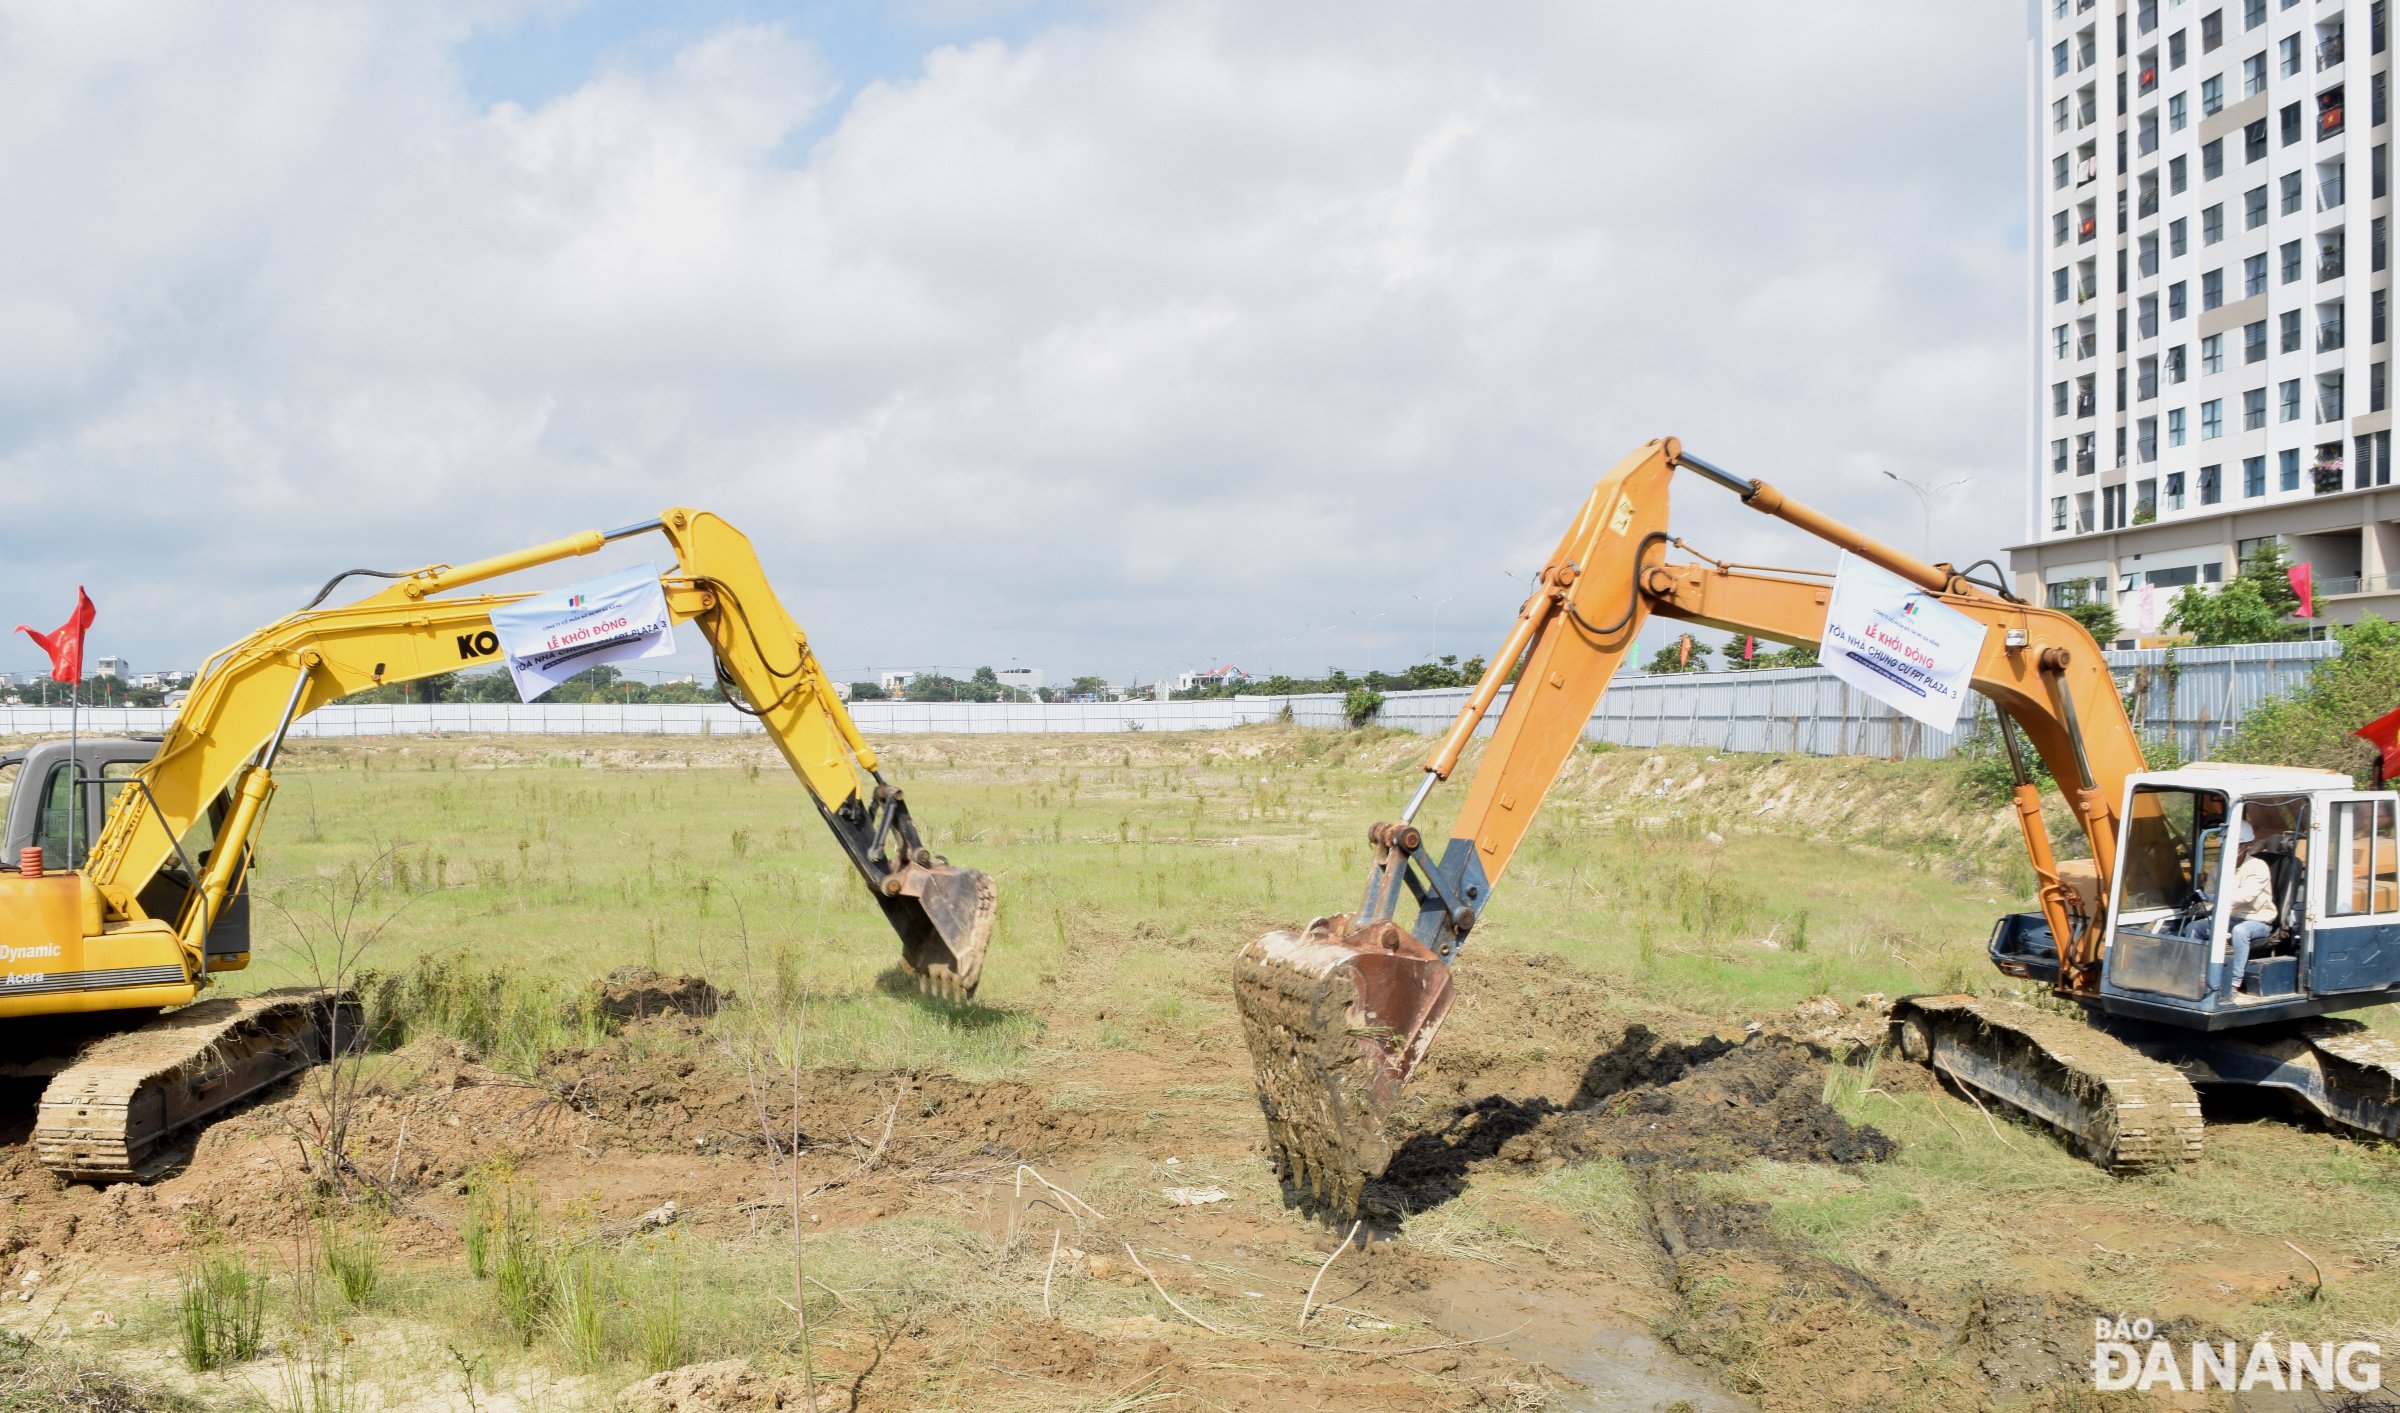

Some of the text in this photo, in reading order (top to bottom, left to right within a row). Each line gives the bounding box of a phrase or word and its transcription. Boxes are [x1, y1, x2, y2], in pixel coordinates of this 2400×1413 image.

[547, 617, 627, 650] LỄ KHỞI ĐỘNG
[661, 620, 667, 628] 3
[1878, 631, 1902, 653] KHỞI
[1904, 646, 1935, 669] ĐỘNG
[1868, 646, 1898, 667] CHUNG
[1897, 662, 1912, 674] CƯ
[1909, 667, 1925, 681] FPT
[1923, 676, 1949, 696] PLAZA
[1950, 690, 1957, 700] 3
[0, 942, 61, 963] Dynamic
[6, 972, 44, 985] Acera
